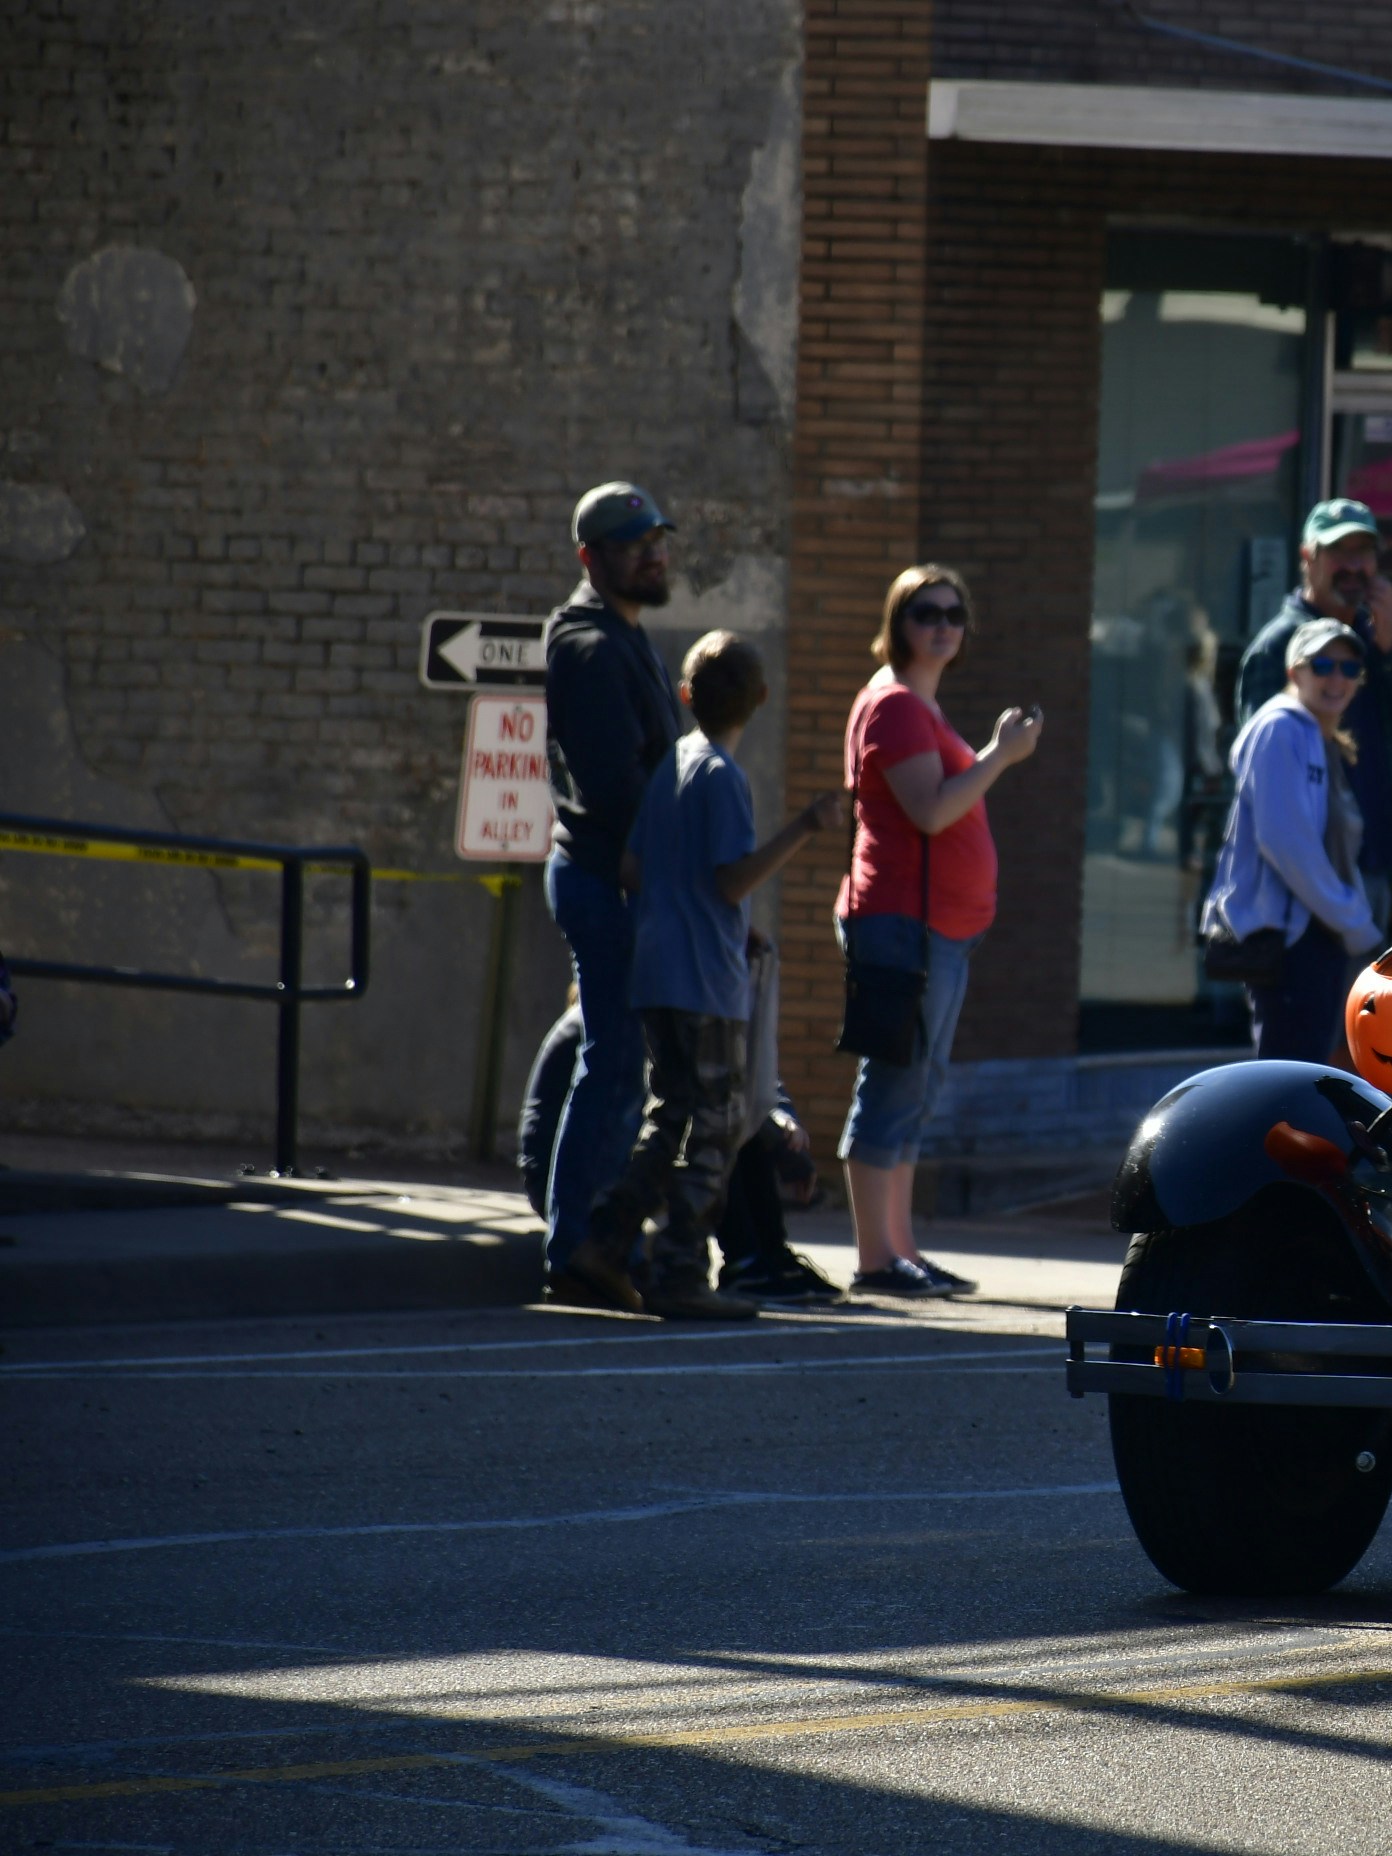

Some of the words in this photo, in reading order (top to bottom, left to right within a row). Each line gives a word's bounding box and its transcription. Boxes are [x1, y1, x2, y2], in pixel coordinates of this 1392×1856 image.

[482, 642, 529, 666] ONE
[500, 711, 534, 742] NO
[500, 791, 518, 810] IN
[481, 820, 534, 842] ALLEY
